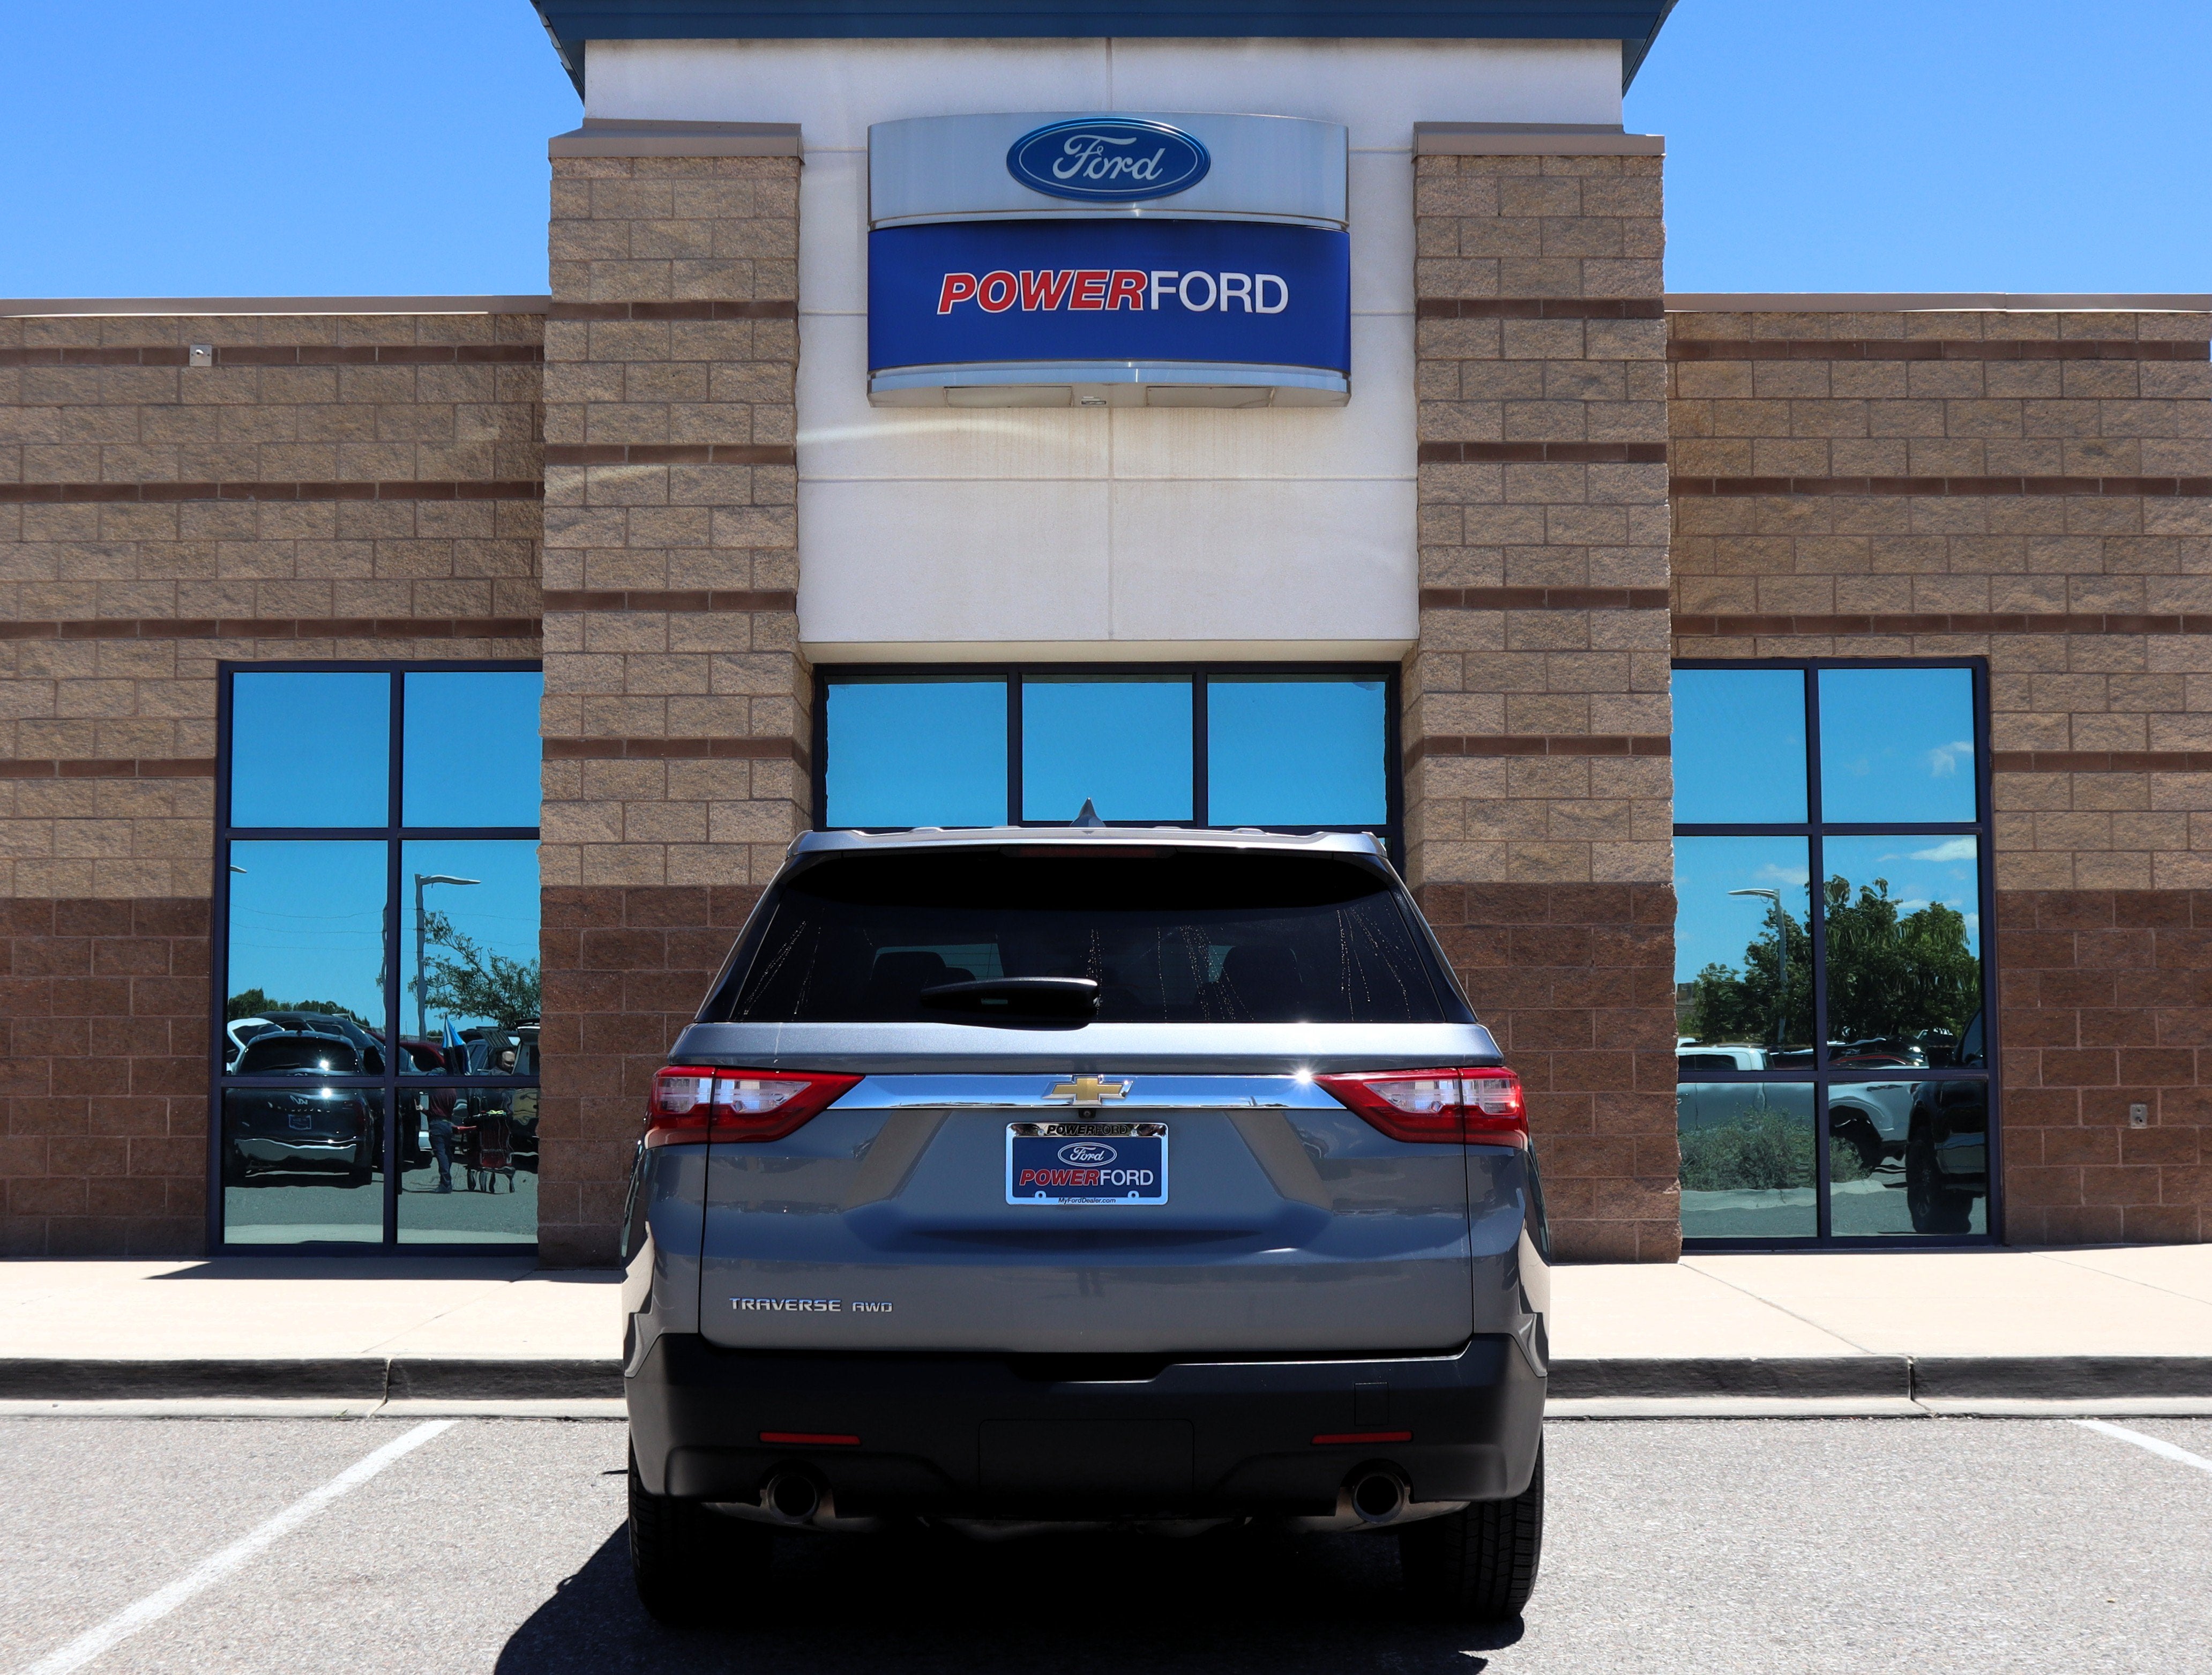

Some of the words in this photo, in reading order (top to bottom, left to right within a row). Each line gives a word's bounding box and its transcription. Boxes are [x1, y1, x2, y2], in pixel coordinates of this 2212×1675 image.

[1052, 134, 1165, 180] Ford
[1070, 1146, 1105, 1162] Ford
[729, 1297, 841, 1312] TRAVERSE
[851, 1301, 893, 1313] AWD
